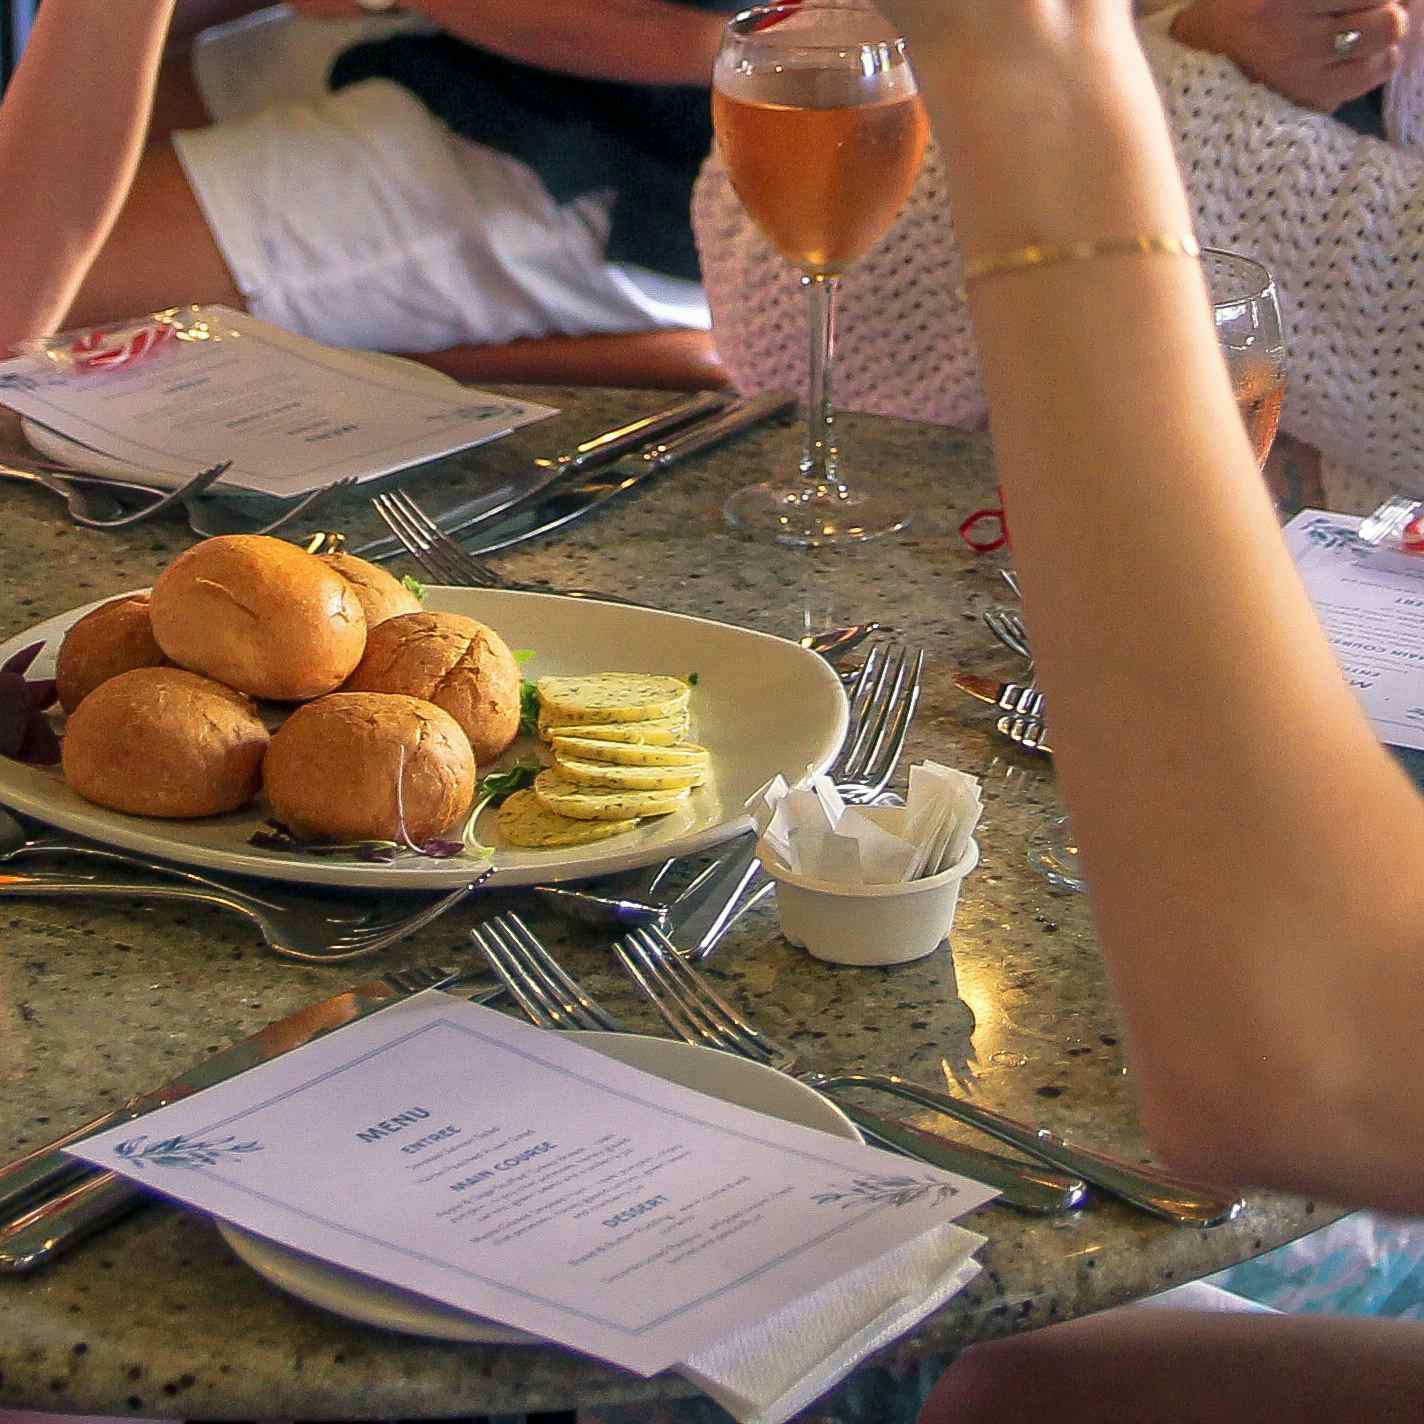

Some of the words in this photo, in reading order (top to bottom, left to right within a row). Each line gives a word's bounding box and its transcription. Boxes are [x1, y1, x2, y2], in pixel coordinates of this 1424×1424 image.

[355, 1105, 431, 1144] MENU
[400, 1123, 463, 1155] ENTREE
[449, 1168, 496, 1192] MAIN
[493, 1140, 558, 1171] COURSE
[602, 1194, 668, 1227] DESSERT
